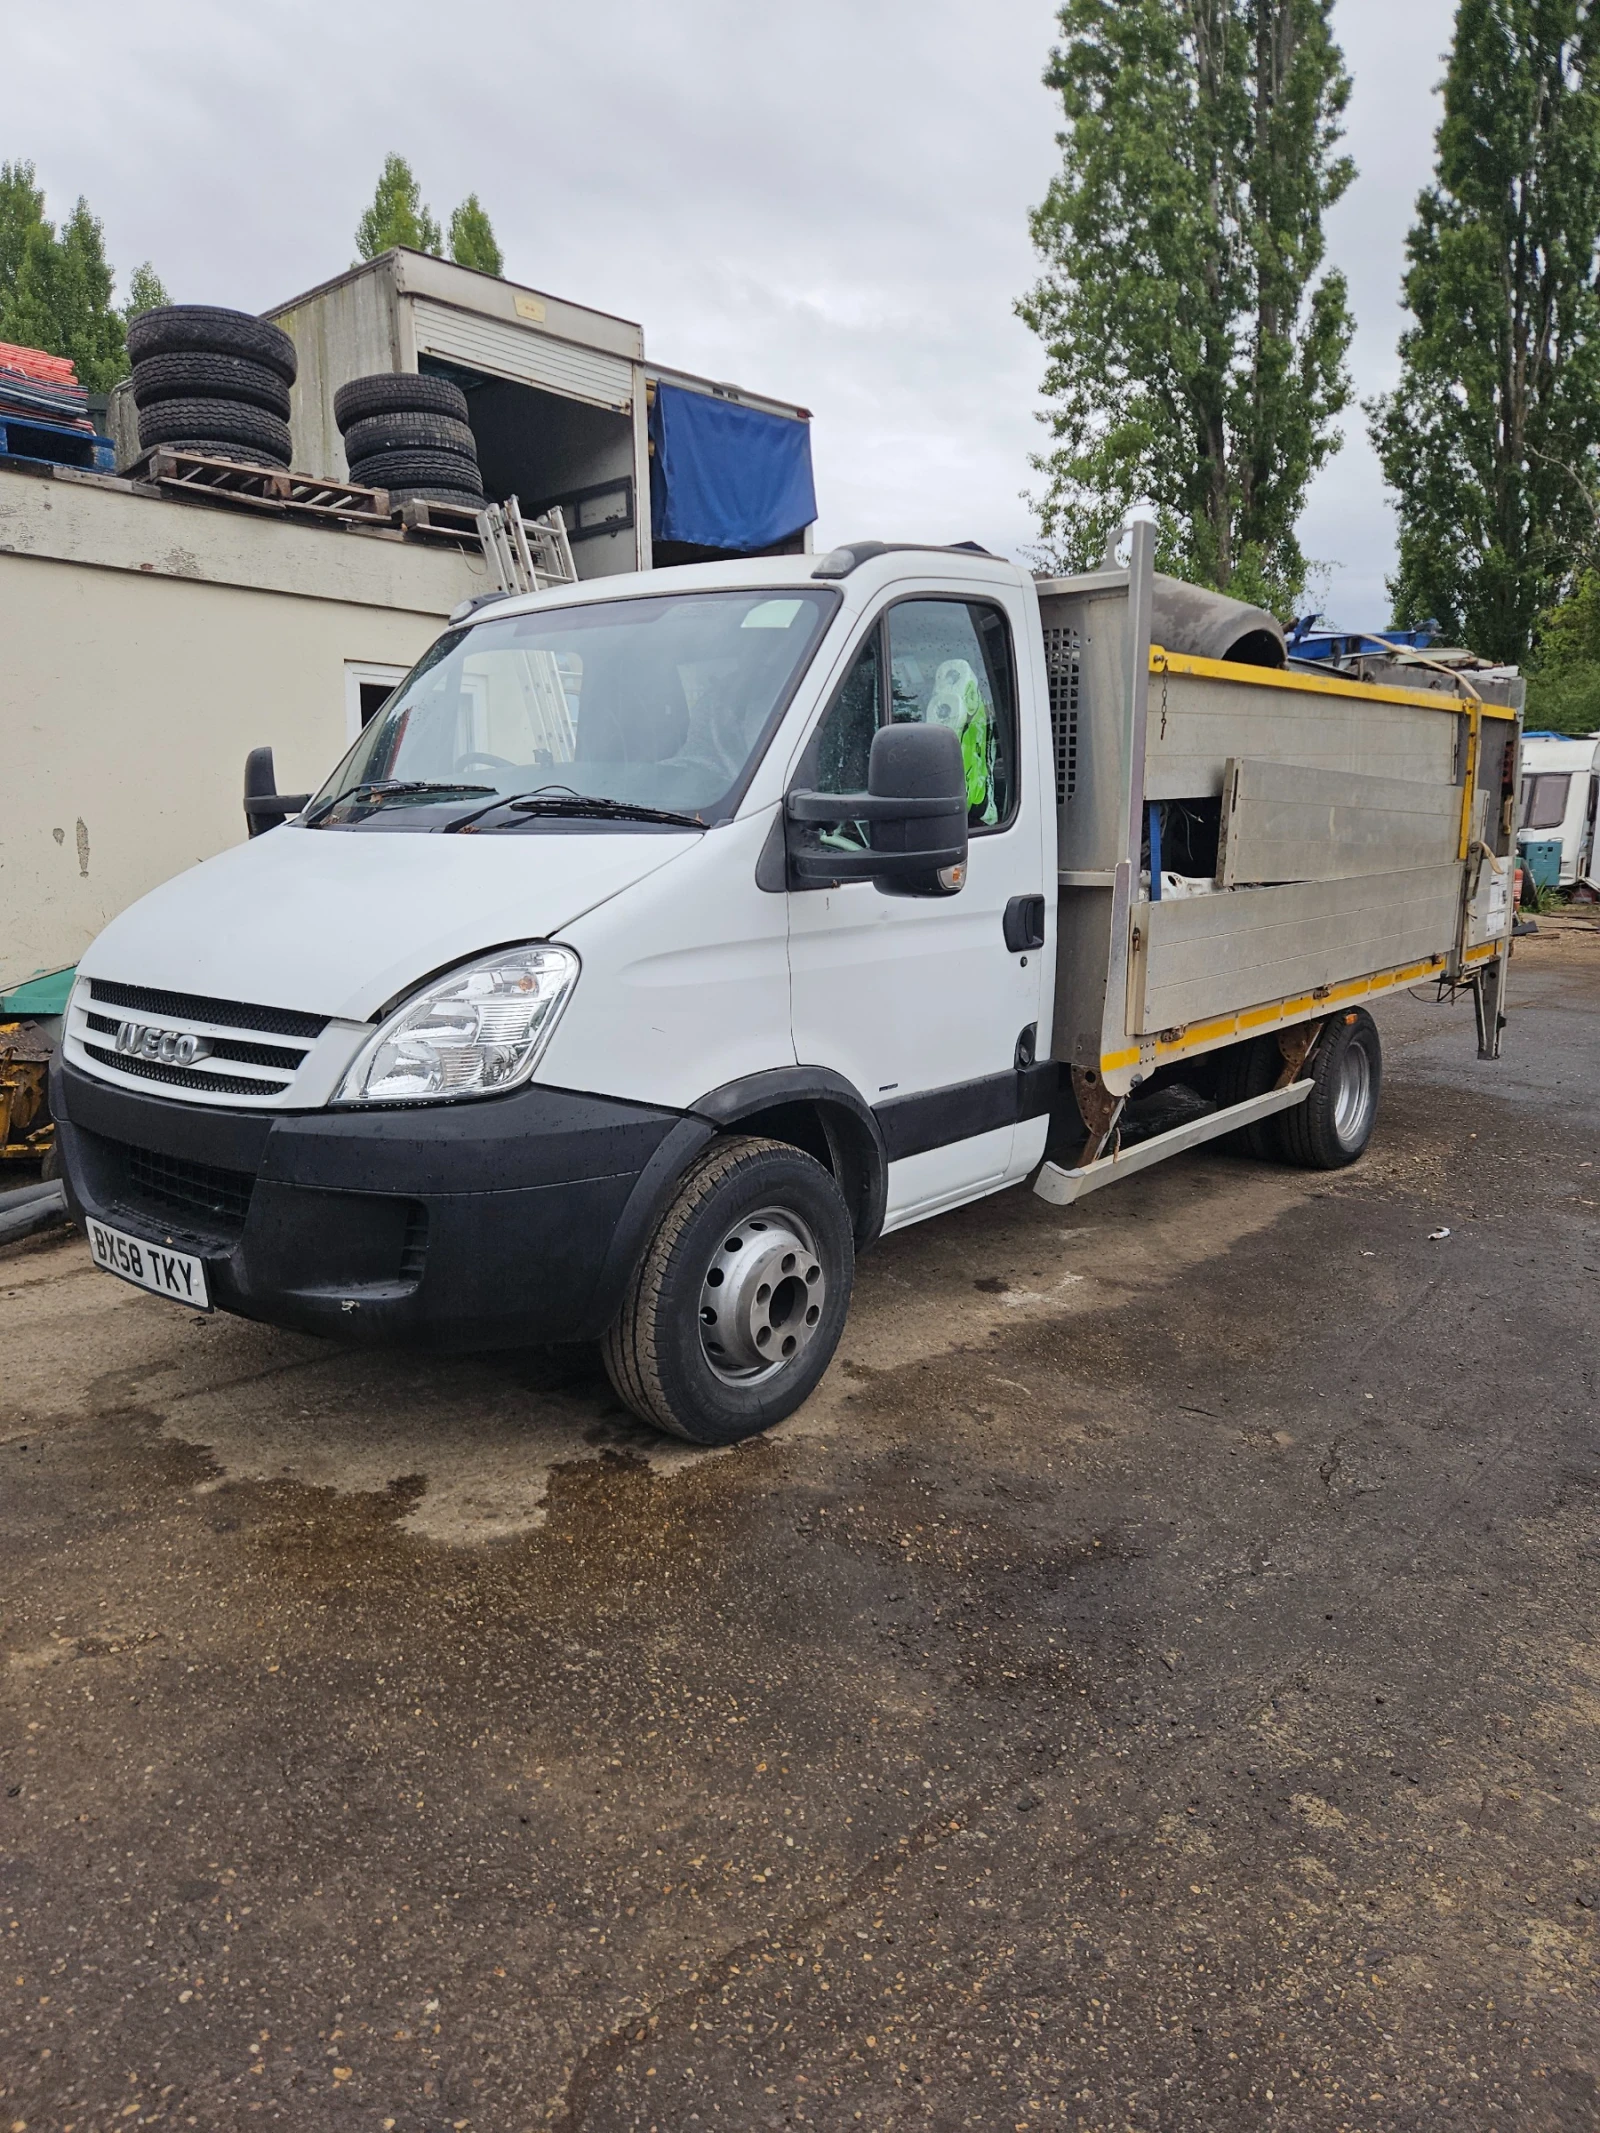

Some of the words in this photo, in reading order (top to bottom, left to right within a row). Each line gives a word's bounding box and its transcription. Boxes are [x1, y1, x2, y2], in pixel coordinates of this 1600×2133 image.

[115, 1022, 199, 1066] IVECO
[93, 1225, 144, 1278] BX58
[147, 1249, 192, 1297] TKY
